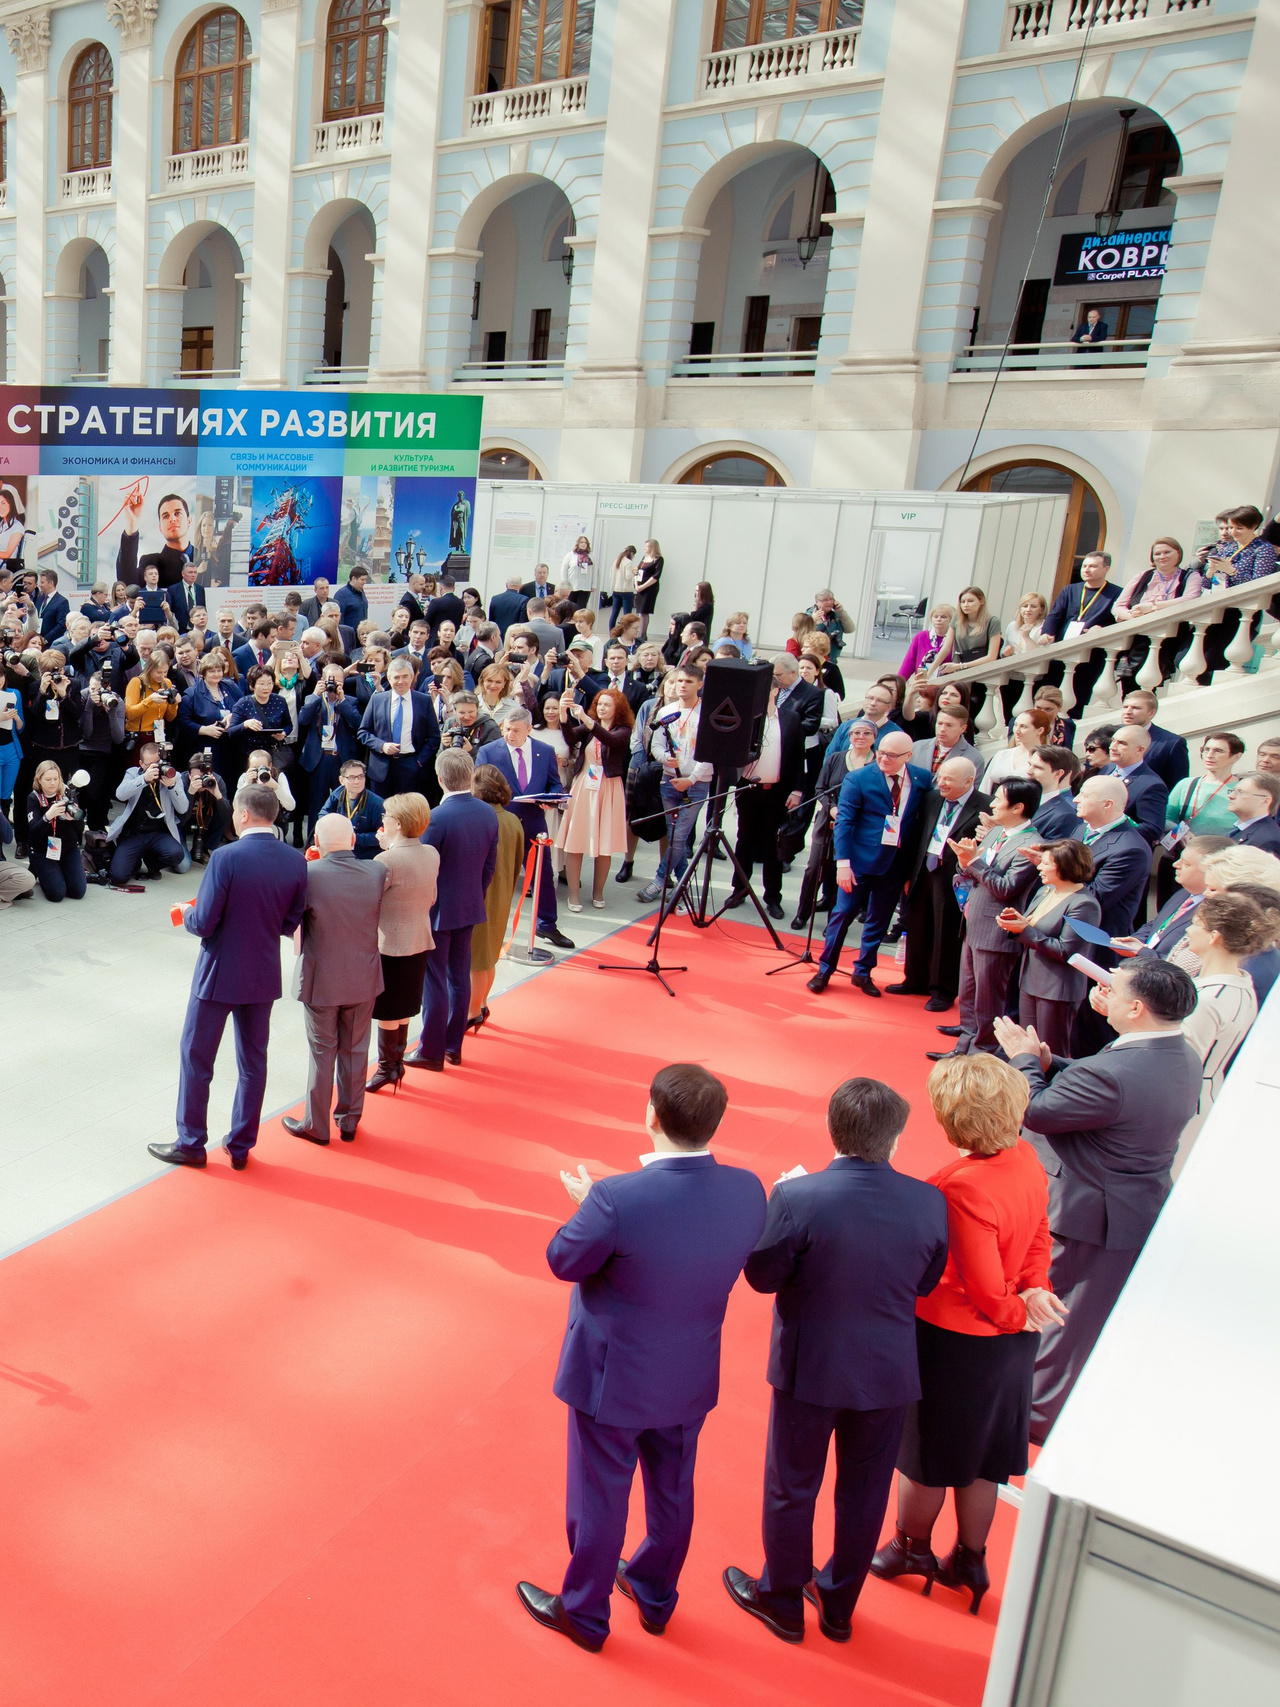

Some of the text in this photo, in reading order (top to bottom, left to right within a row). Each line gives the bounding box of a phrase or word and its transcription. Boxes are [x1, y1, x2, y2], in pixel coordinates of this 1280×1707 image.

[1096, 269, 1166, 281] Carpet PLAZA
[7, 404, 247, 436] СТРАТЕГИЯХ
[260, 409, 437, 439] РАЗВИТИЯ
[62, 456, 176, 465] ЭКОНОМИКА И ФИНАНСЫ
[230, 452, 314, 461] СВЯЗЬ И МАССОВЫЕ
[393, 454, 434, 462] КУЛЬТУРА
[236, 463, 307, 473] КОММУНИКАЦИИ
[371, 464, 455, 472] И РАЗВИТИЕ ТУРИЗМА
[599, 502, 649, 511] ПРЕСС-ЦЕНТР
[900, 512, 917, 520] VIP
